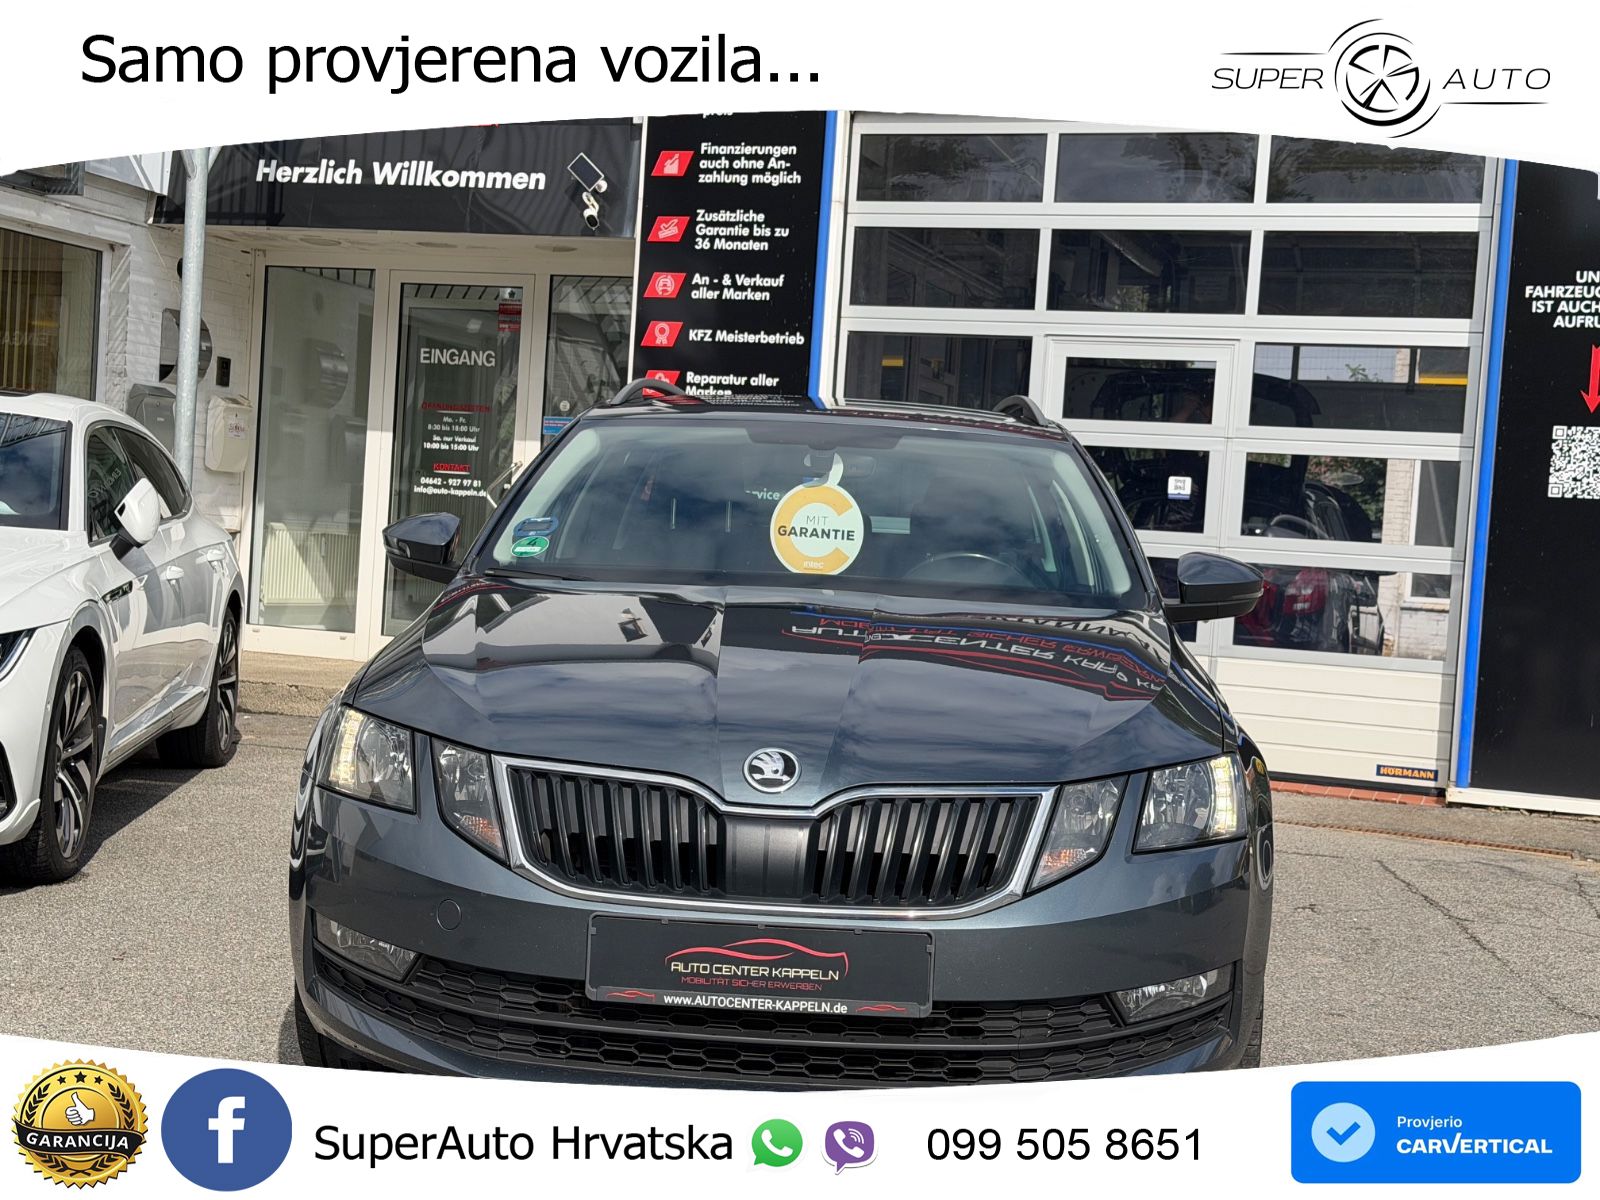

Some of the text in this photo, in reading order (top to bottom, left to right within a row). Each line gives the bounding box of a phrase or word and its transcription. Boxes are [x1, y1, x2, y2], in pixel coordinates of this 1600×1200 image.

[700, 143, 797, 157] Finanzierungen
[699, 157, 791, 169] auch ohne An-
[256, 159, 546, 190] Herzlich Willkommen
[698, 171, 801, 186] zahlung möglich
[696, 209, 765, 222] Zusätzliche
[695, 223, 790, 237] Garantie bis zu
[695, 238, 769, 250] 36 Monaten
[692, 273, 710, 285] An
[722, 274, 732, 286] &
[735, 274, 785, 287] Verkauf
[691, 287, 770, 301] aller Marken
[1532, 300, 1600, 313] IST AUCH
[689, 330, 804, 345] KFZ Meisterbetrieb
[420, 348, 496, 367] EINGANG
[686, 371, 779, 386] Reparatur aller
[448, 478, 461, 486] 927
[806, 515, 829, 526] MIT
[778, 525, 856, 541] GARANTIE
[671, 961, 839, 981] AUTO CENTER KAPPELN
[681, 976, 823, 991] MOBILITÄT SICHER ERWERBEN
[664, 994, 848, 1014] www.AUTOCENTER-KAPPELN.de
